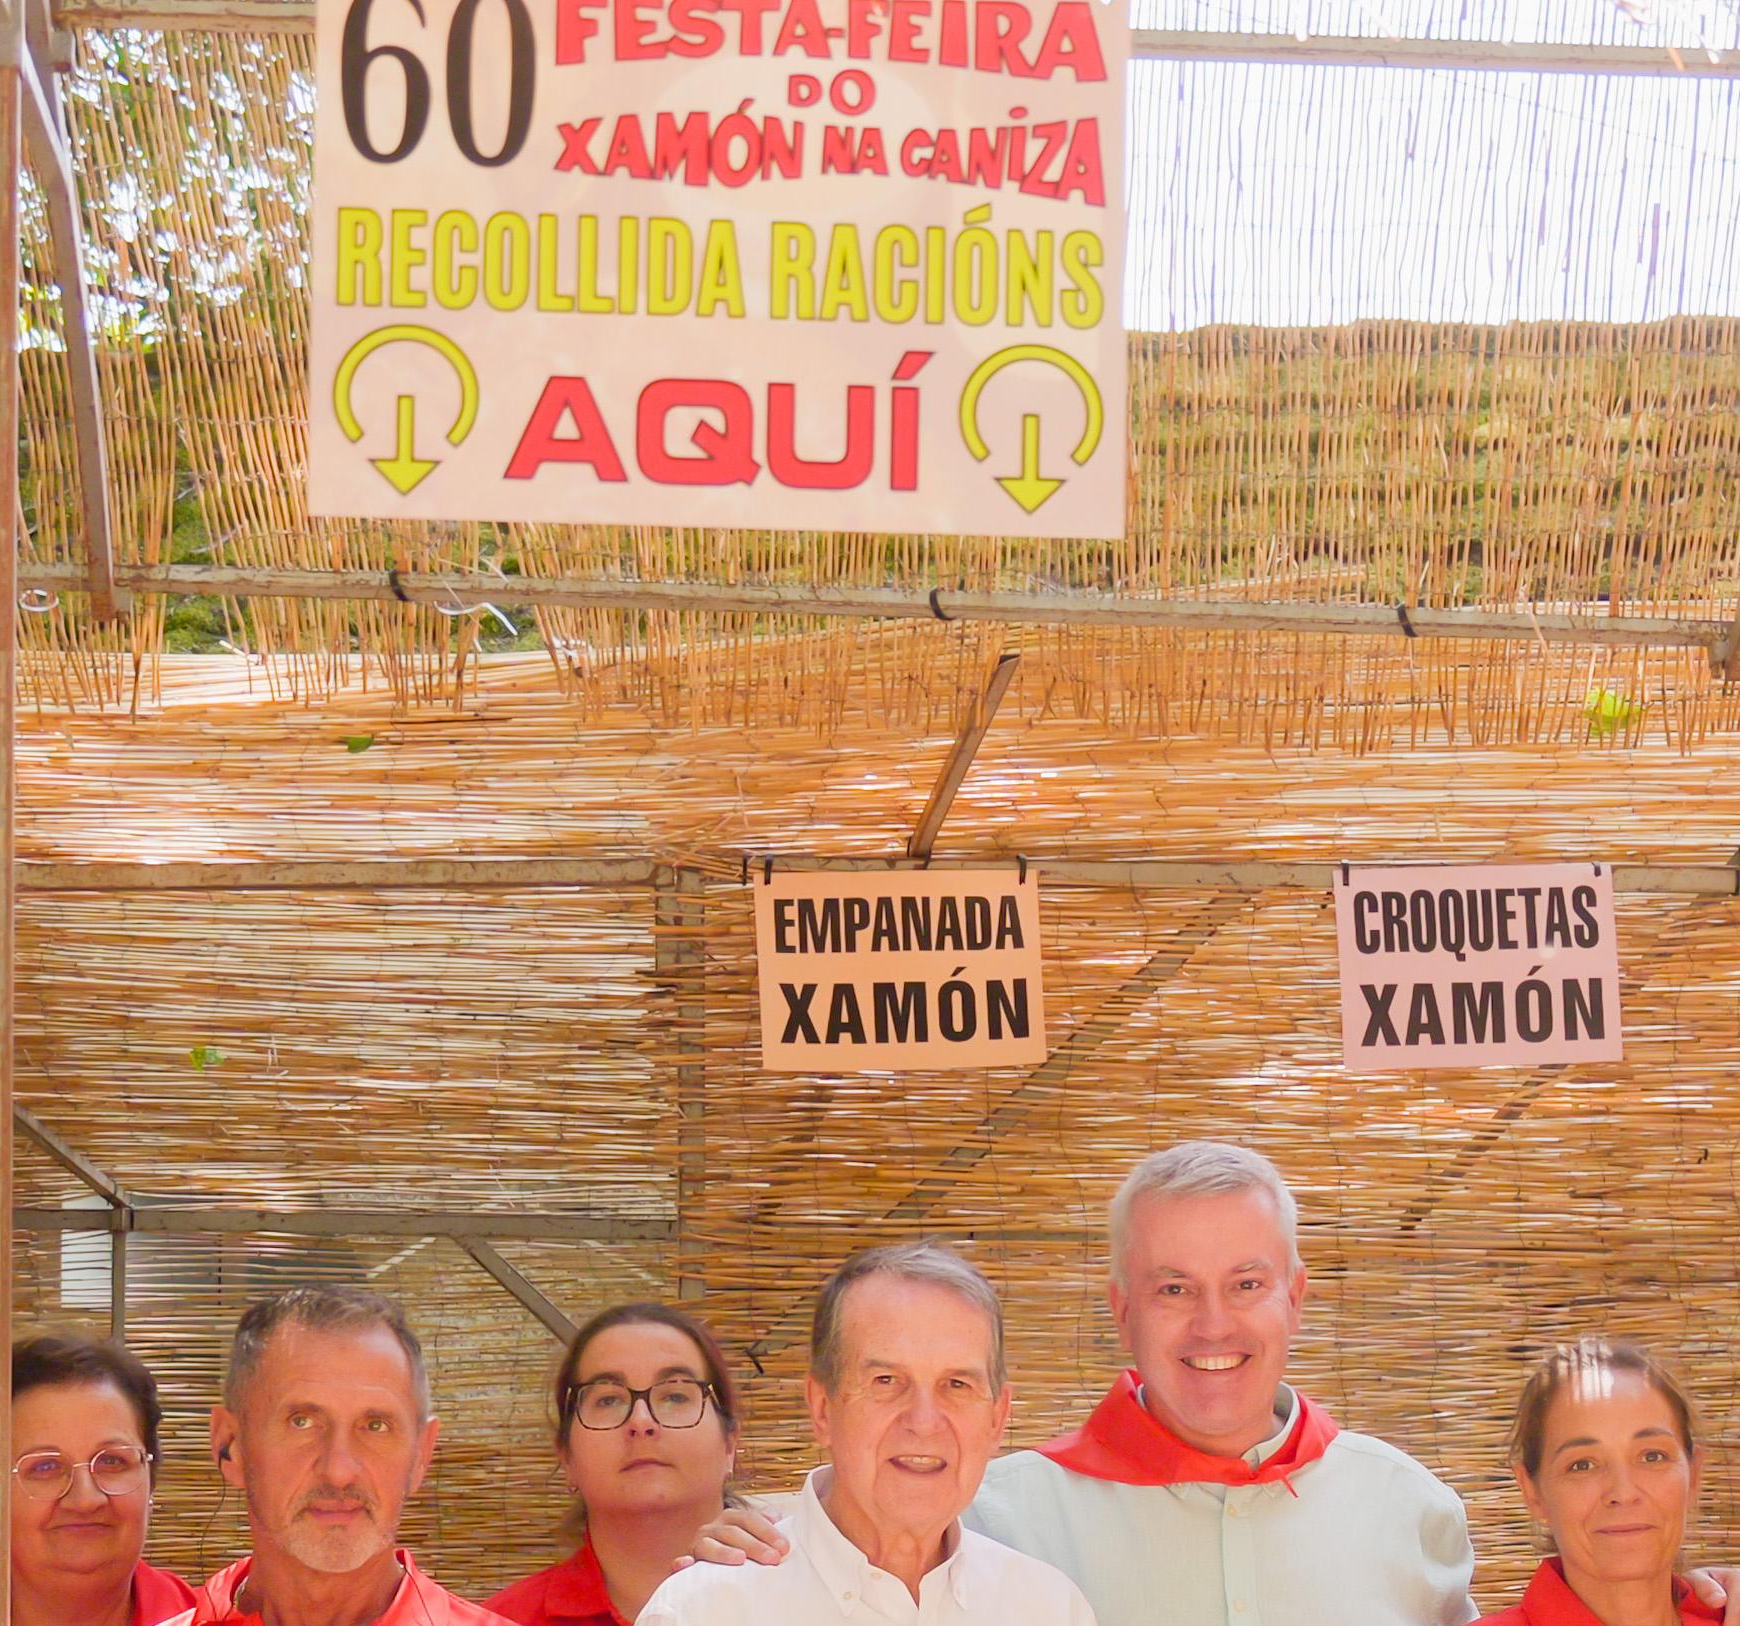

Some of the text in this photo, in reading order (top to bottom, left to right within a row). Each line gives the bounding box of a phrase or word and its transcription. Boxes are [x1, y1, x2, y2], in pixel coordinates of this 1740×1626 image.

[554, 0, 1108, 82] FESTA-FEIRA
[340, 0, 536, 167] 60
[788, 69, 876, 115] DO
[554, 98, 803, 187] XAMÓN
[821, 125, 888, 176] NA
[335, 204, 1104, 329] RECOLLIDA RACIÓNS
[503, 350, 936, 492] AQUÍ
[773, 895, 1024, 954] EMPANADA
[1353, 885, 1599, 962] CROQUETAS
[779, 966, 1030, 1044] XAMÓN
[1360, 965, 1605, 1047] XAMÓN
